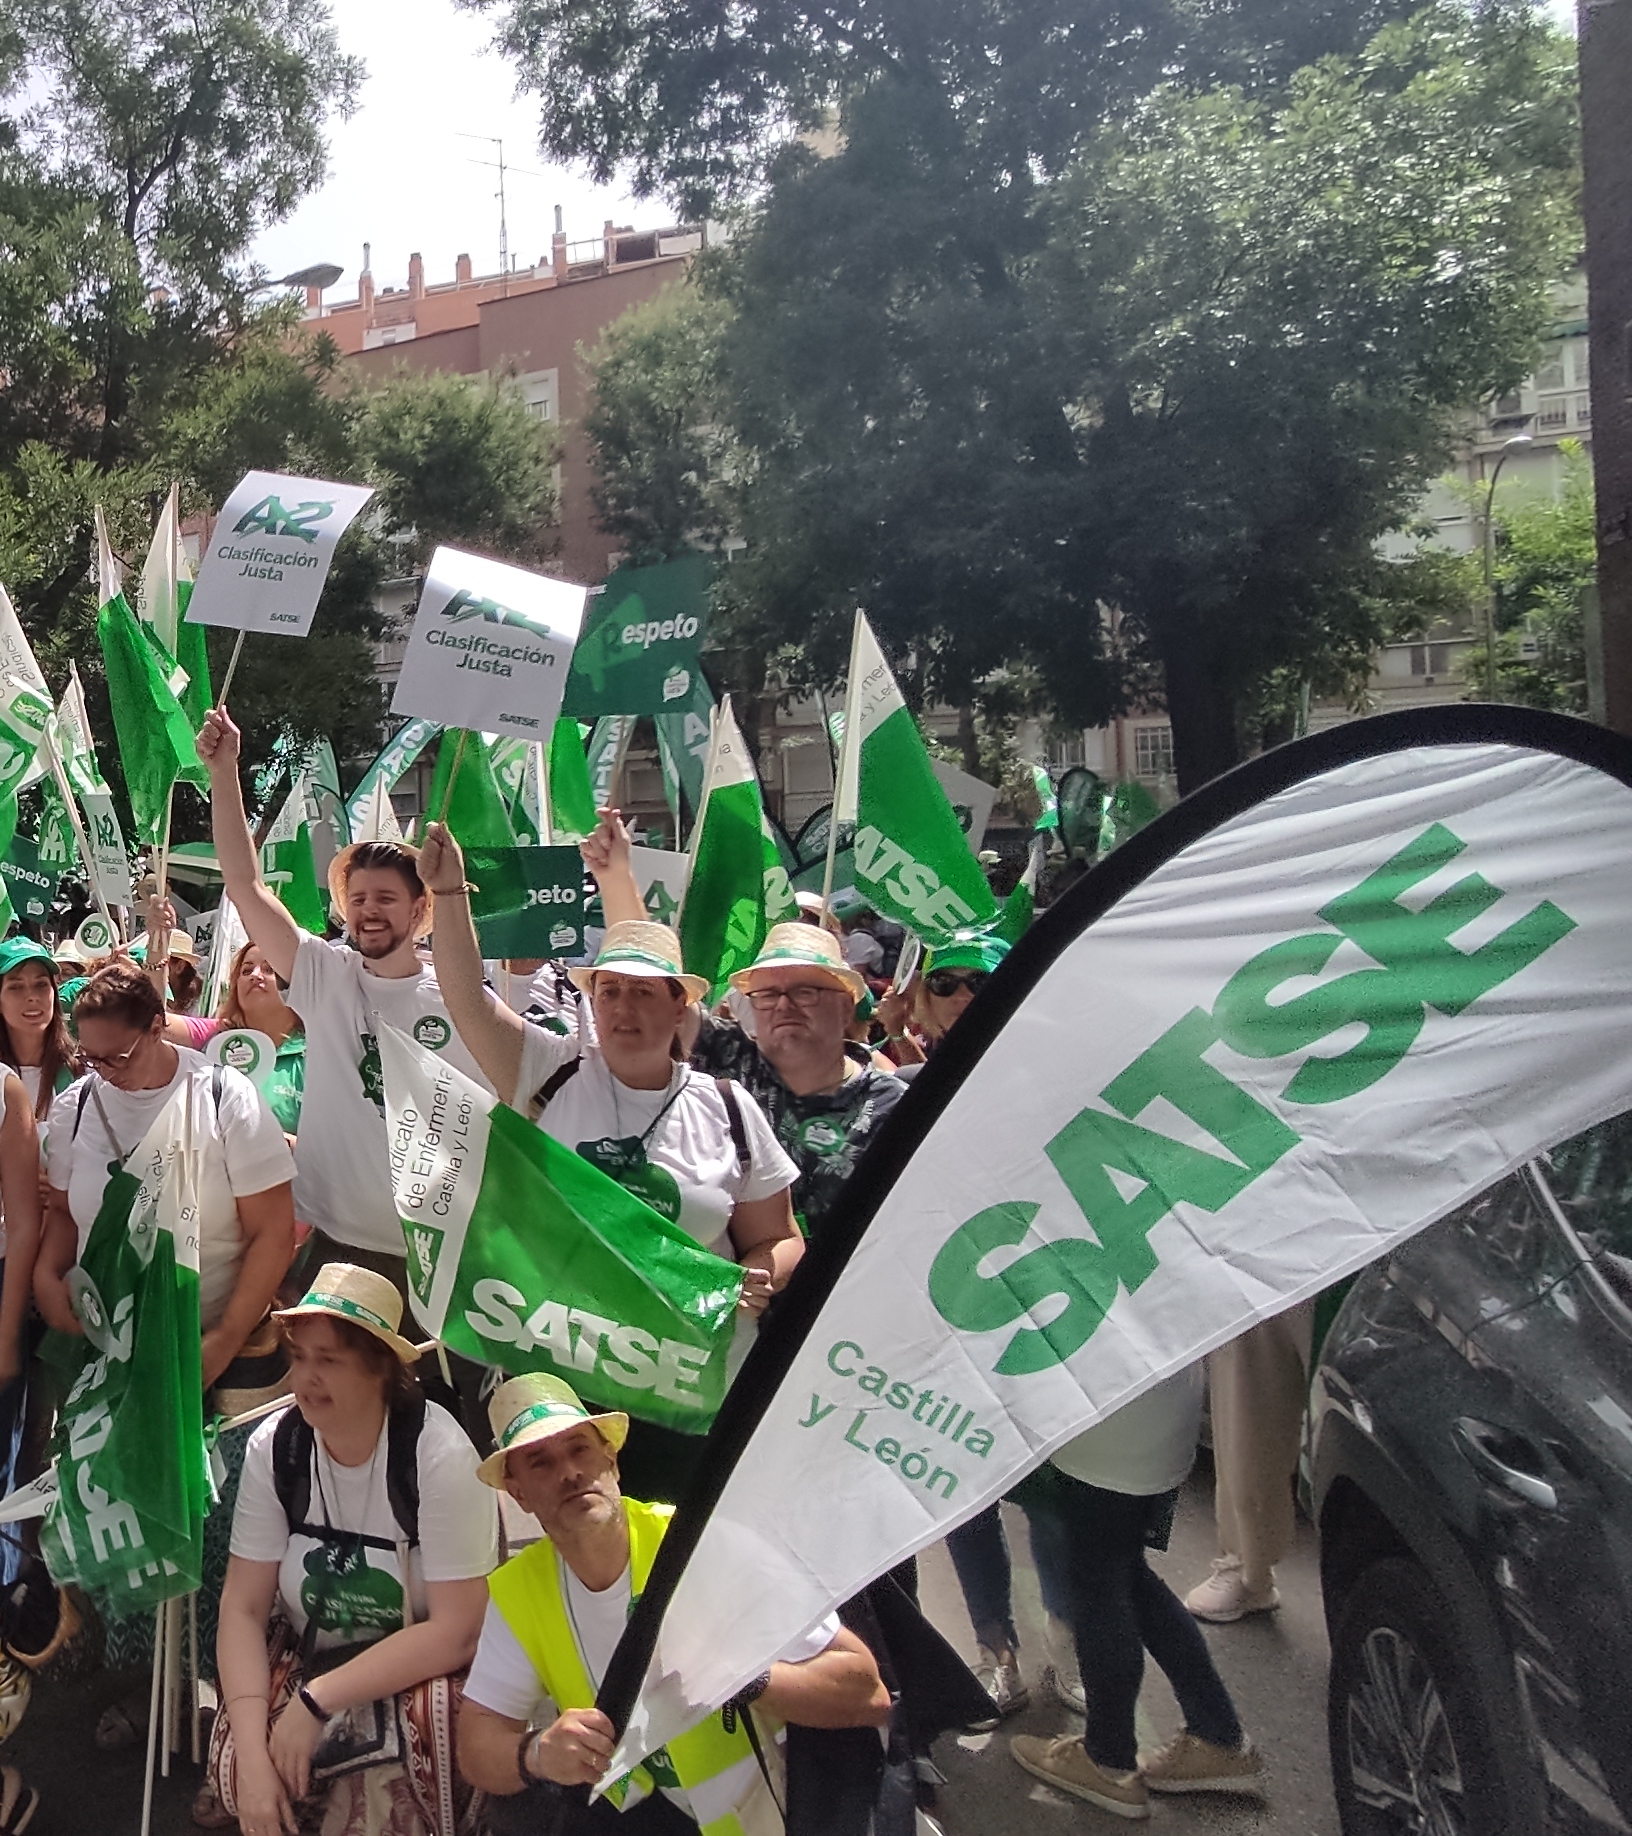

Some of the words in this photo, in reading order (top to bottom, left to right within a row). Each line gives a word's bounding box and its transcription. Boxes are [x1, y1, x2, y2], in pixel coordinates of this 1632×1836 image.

[218, 546, 319, 569] Clasificación
[238, 563, 284, 582] Justa
[269, 612, 301, 624] SATSE
[425, 628, 556, 668] Clasificación
[456, 651, 513, 679] Justa
[499, 712, 540, 729] SATSE
[0, 859, 51, 889] espeto
[853, 824, 978, 931] ATSE
[928, 821, 1579, 1377] SATSE
[407, 1182, 427, 1210] de
[432, 1157, 463, 1217] Castilla
[453, 1142, 469, 1154] y
[464, 1277, 712, 1408] SATSE
[826, 1338, 997, 1460] Castilla
[799, 1389, 828, 1427] y
[843, 1407, 965, 1502] León
